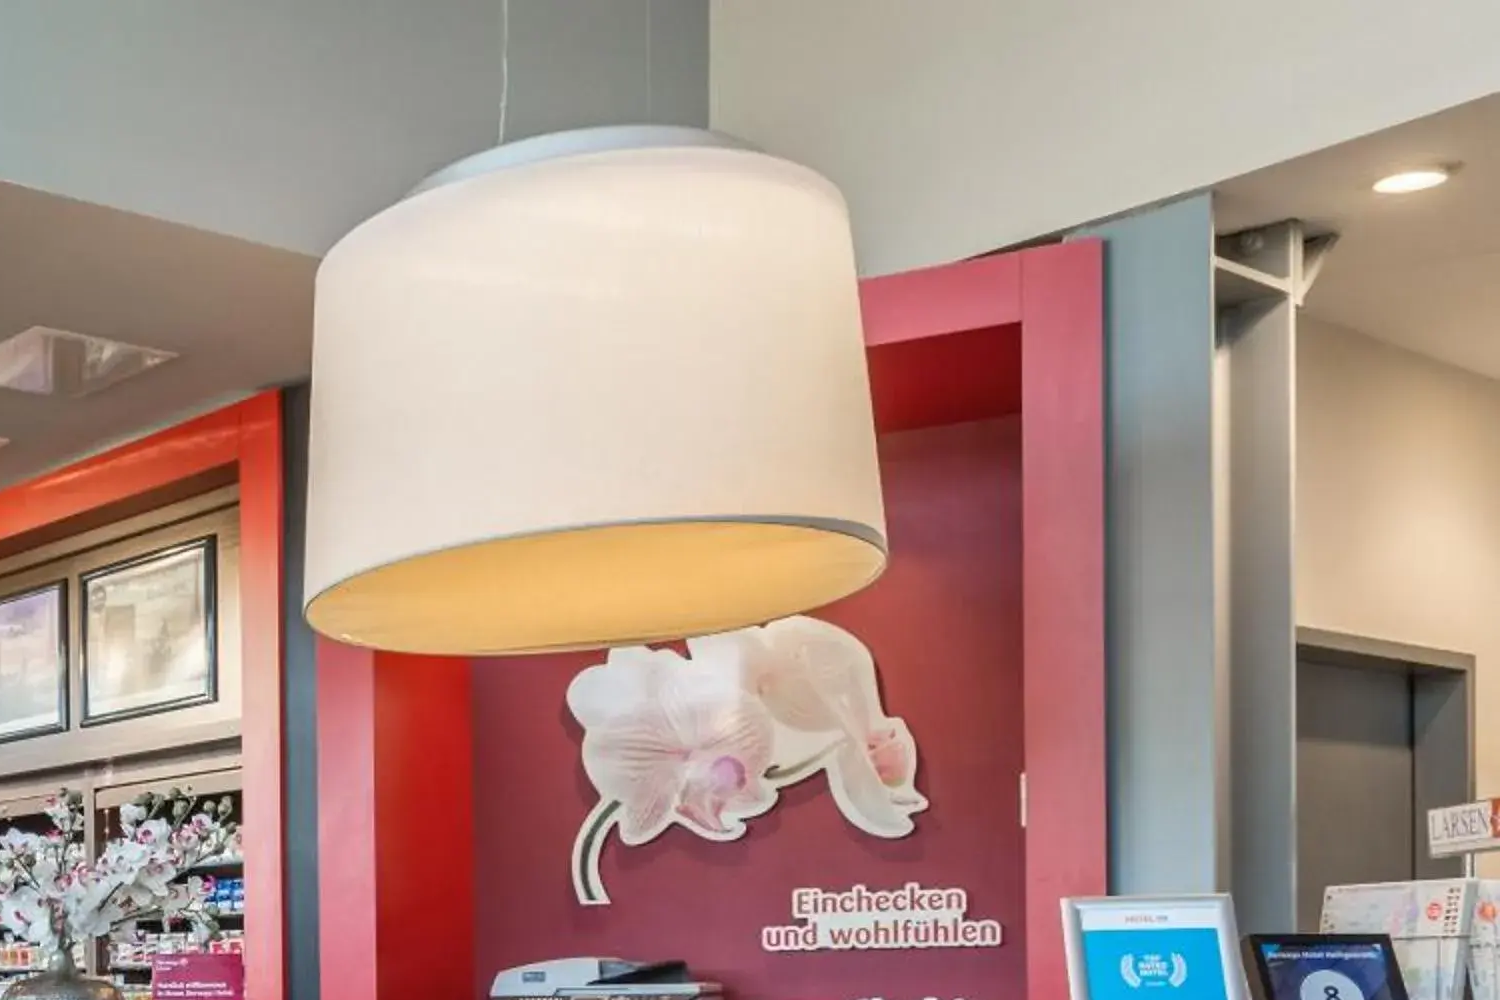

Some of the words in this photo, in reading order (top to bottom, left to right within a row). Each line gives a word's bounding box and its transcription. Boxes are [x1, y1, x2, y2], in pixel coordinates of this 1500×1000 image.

[1430, 806, 1489, 841] LARSEN
[795, 885, 964, 915] Einchecken
[765, 921, 818, 947] und
[829, 918, 998, 945] wohlfühlen
